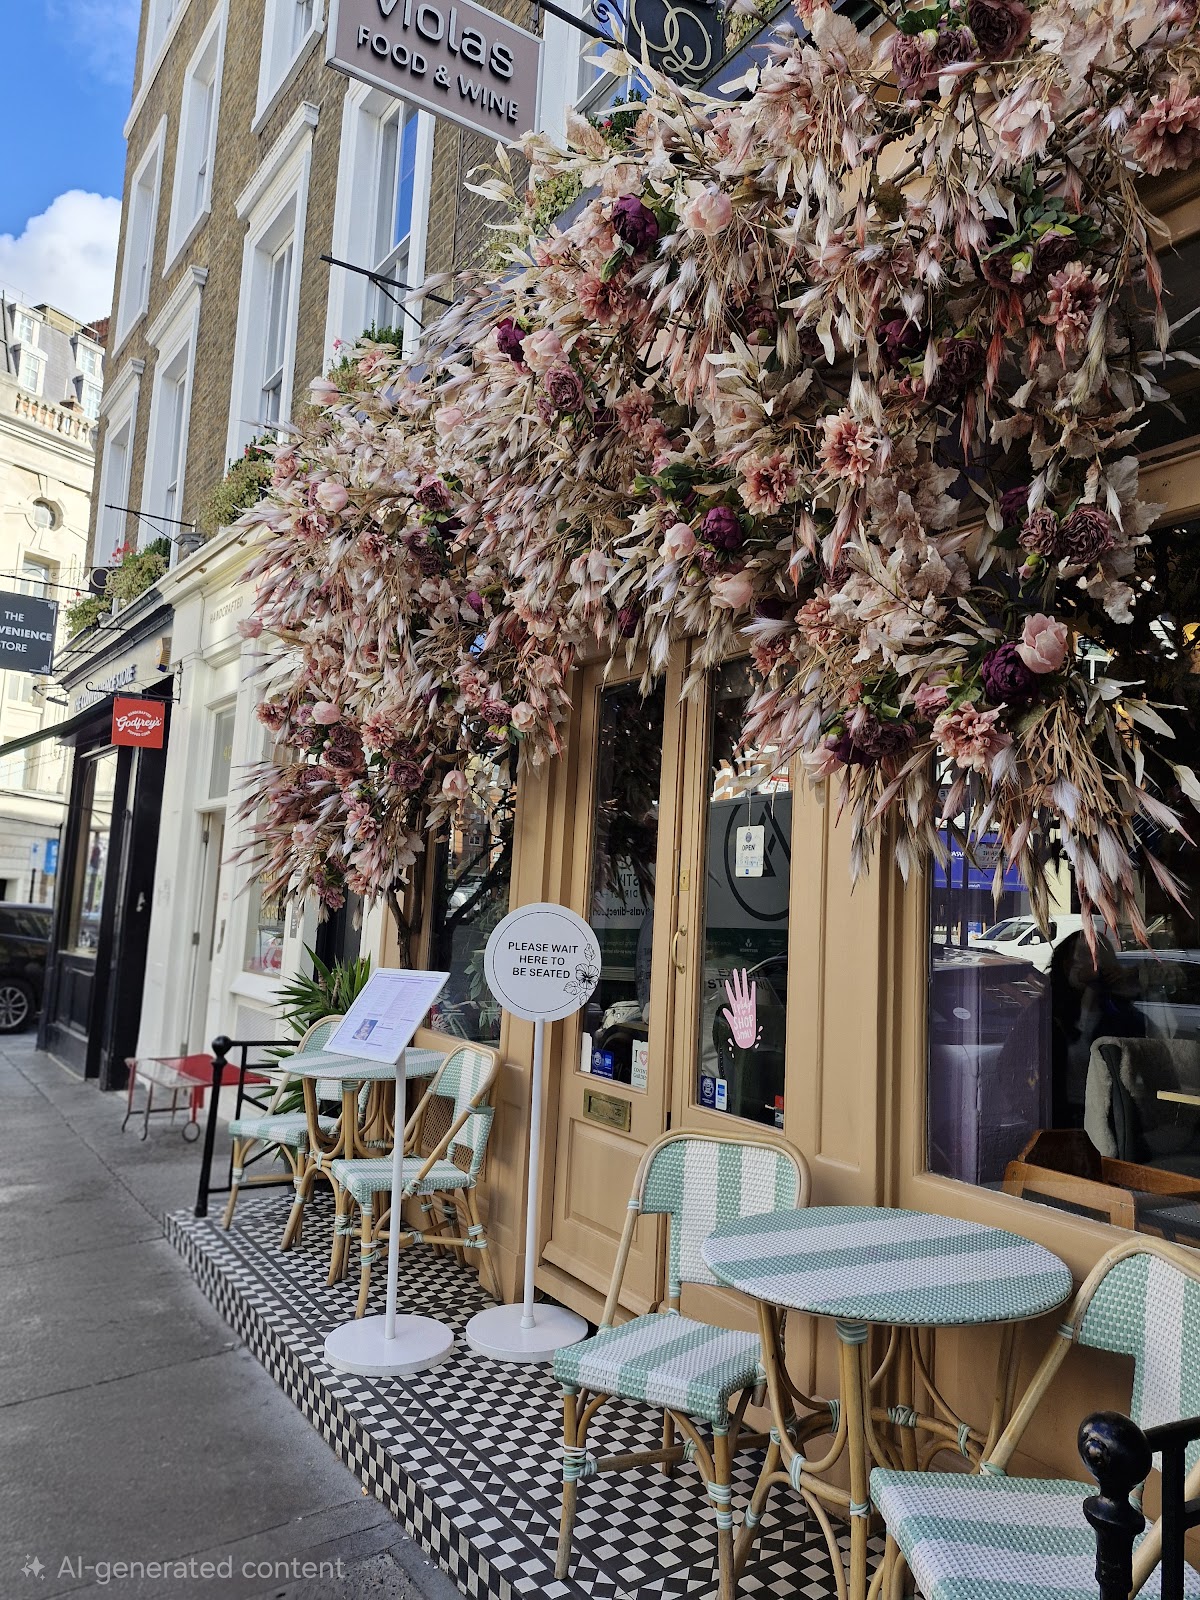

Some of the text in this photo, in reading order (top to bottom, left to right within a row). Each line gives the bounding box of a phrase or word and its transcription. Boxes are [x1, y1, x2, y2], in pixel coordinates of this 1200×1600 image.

[357, 24, 519, 122] FOOD & WINE
[4, 610, 25, 623] THE
[0, 640, 28, 653] TORE
[115, 715, 163, 732] Godfrey's
[741, 844, 756, 852] OPEN
[508, 941, 578, 954] PLEASE WAIT
[519, 955, 565, 966] HERE TO
[512, 967, 570, 979] BE SEATED
[733, 1014, 754, 1030] SHOP
[634, 1049, 639, 1063] I
